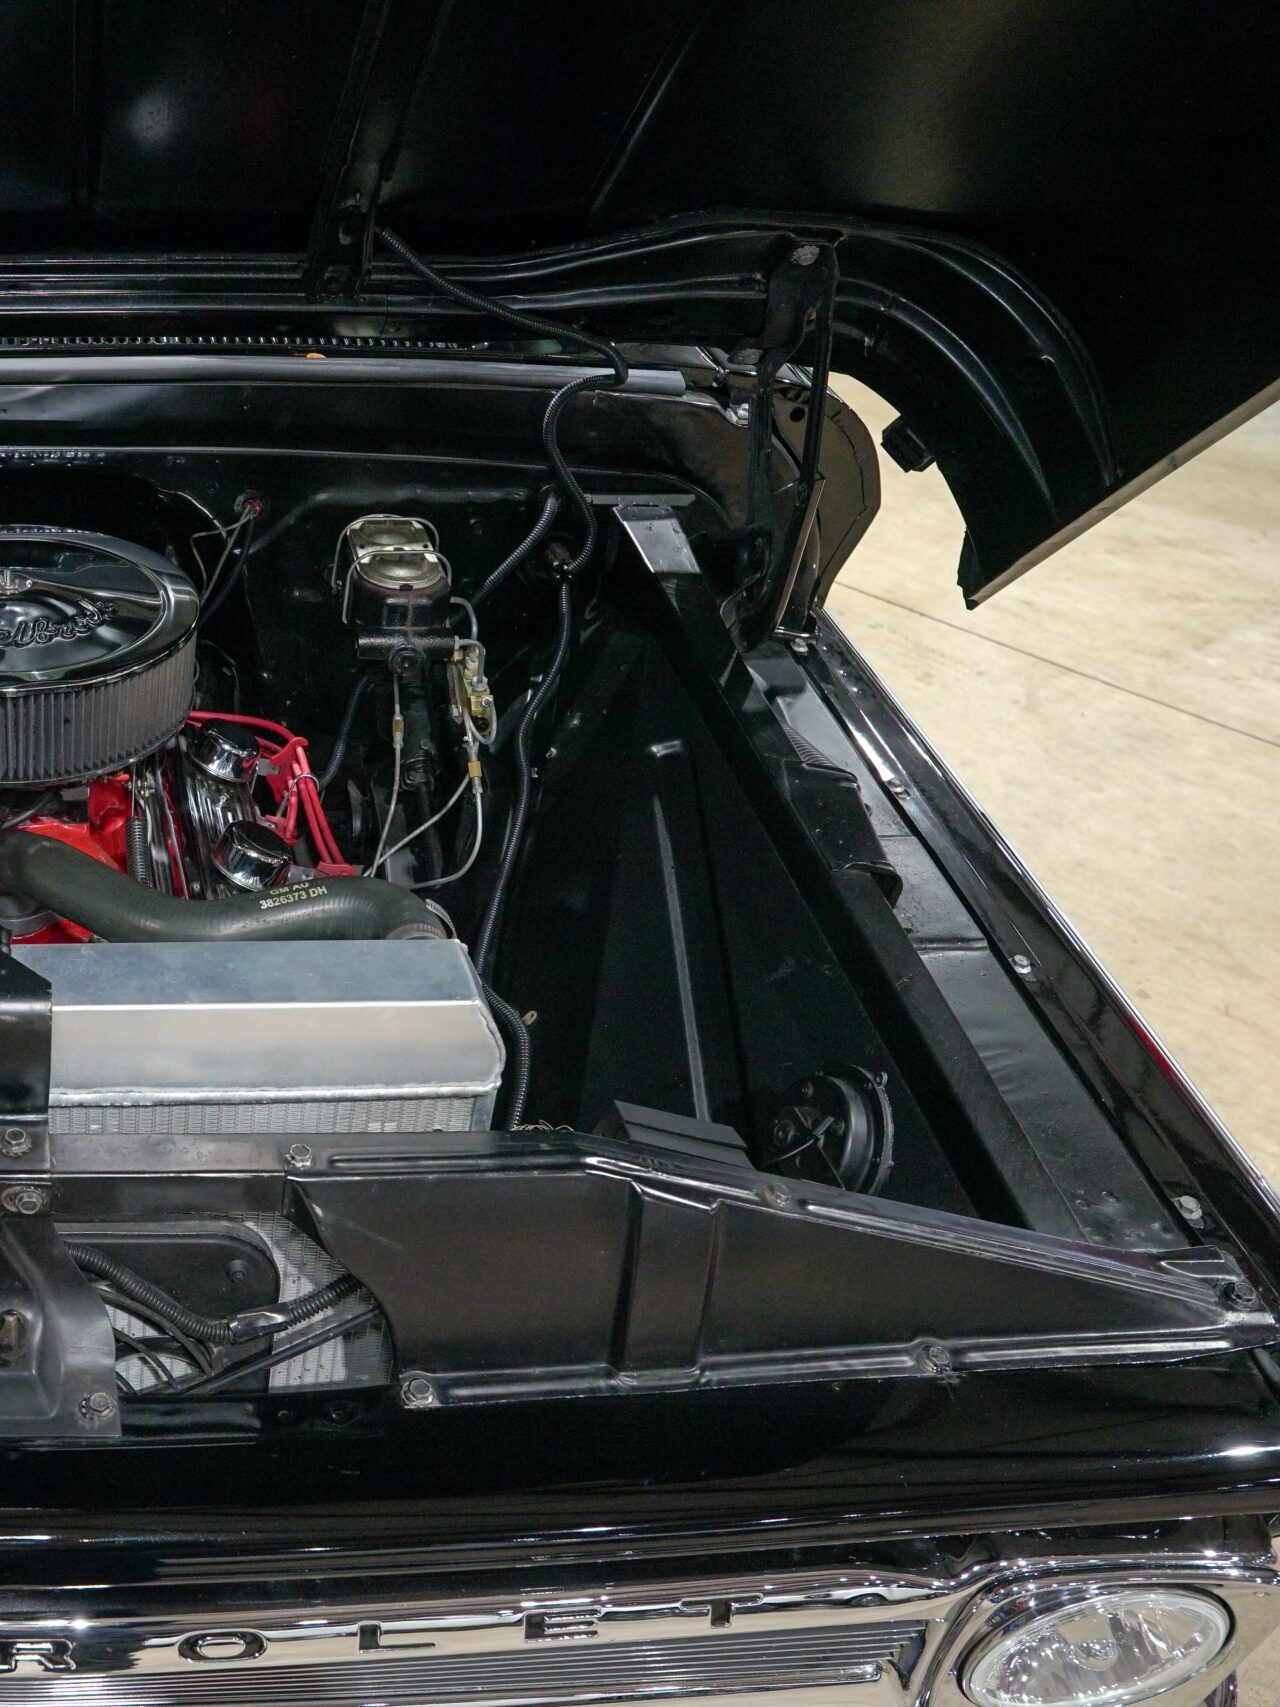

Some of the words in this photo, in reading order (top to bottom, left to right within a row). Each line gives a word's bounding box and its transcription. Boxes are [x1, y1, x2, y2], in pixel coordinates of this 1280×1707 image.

[259, 890, 308, 909] 3826373
[308, 885, 328, 898] DH
[270, 886, 290, 895] GM
